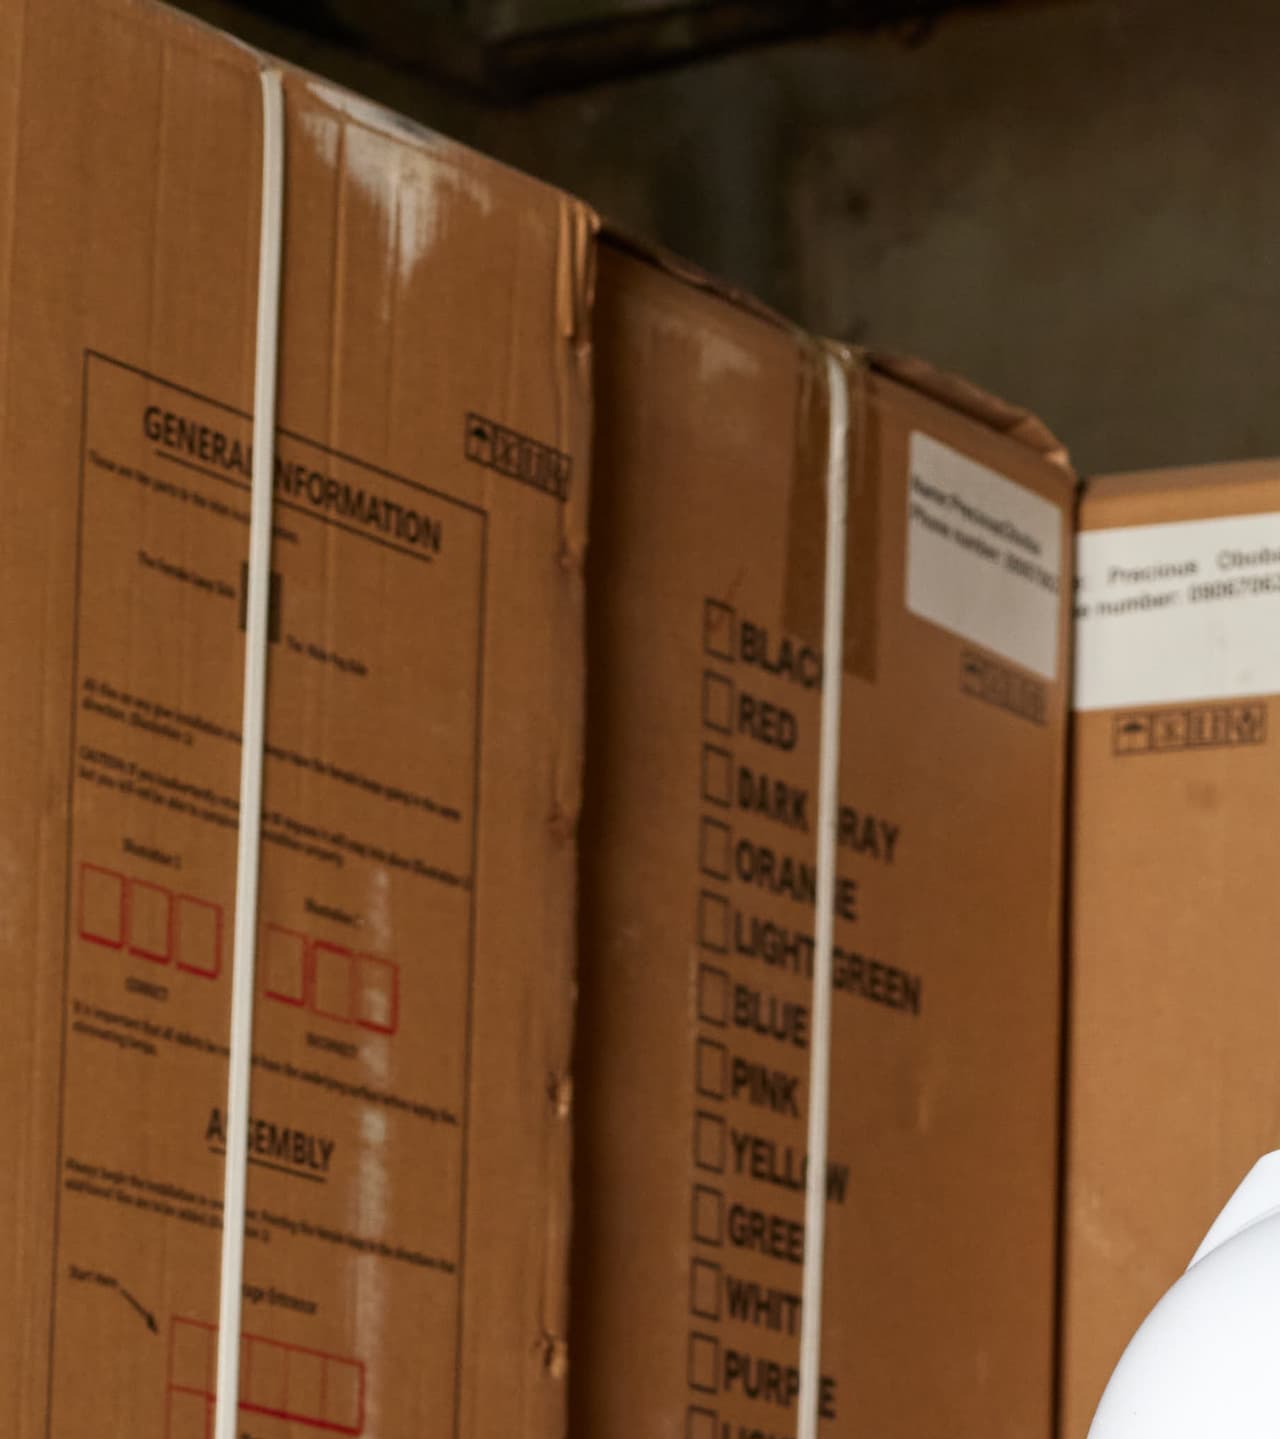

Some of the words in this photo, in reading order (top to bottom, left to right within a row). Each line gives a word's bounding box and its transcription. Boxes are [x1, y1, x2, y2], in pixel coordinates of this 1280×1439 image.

[273, 456, 442, 554] NFORMATION
[737, 621, 823, 689] BLAC
[737, 693, 798, 752] RED
[737, 765, 809, 829] DARK
[838, 808, 900, 866] RAY
[736, 836, 858, 922] ORANE
[733, 910, 814, 980] LIGHT
[733, 984, 809, 1049] BLUE
[730, 1057, 800, 1119] PINK
[205, 1107, 334, 1171] AEMBLY
[731, 1129, 848, 1205] YELLW
[728, 1205, 806, 1265] GREE
[725, 1275, 802, 1336] WHIT
[724, 1349, 836, 1419] PURPE
